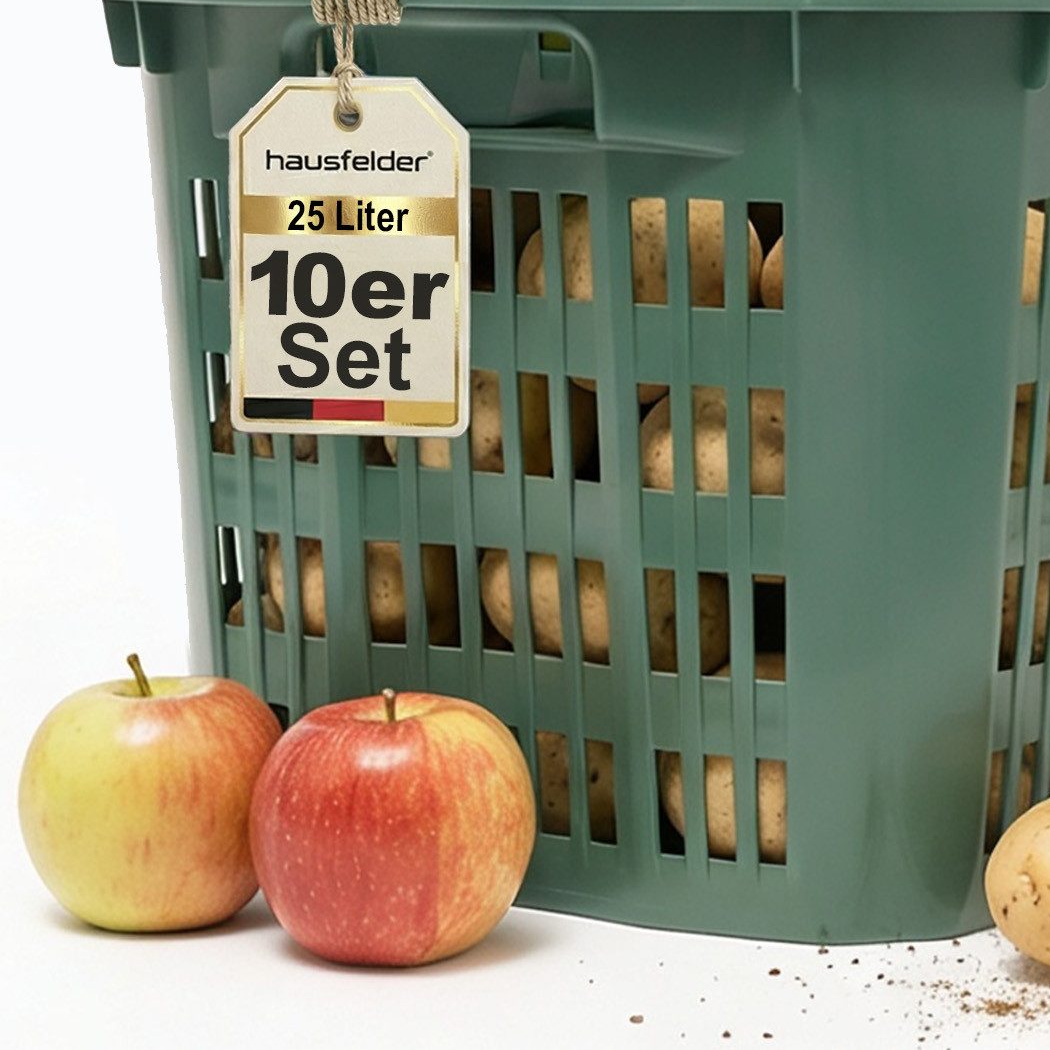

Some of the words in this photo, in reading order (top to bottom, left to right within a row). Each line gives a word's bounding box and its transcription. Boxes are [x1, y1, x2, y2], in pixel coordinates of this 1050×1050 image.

[265, 149, 428, 172] hausfelder
[287, 199, 325, 232] 25
[335, 199, 410, 232] Liter
[250, 249, 450, 320] 10er
[277, 321, 411, 391] Set
